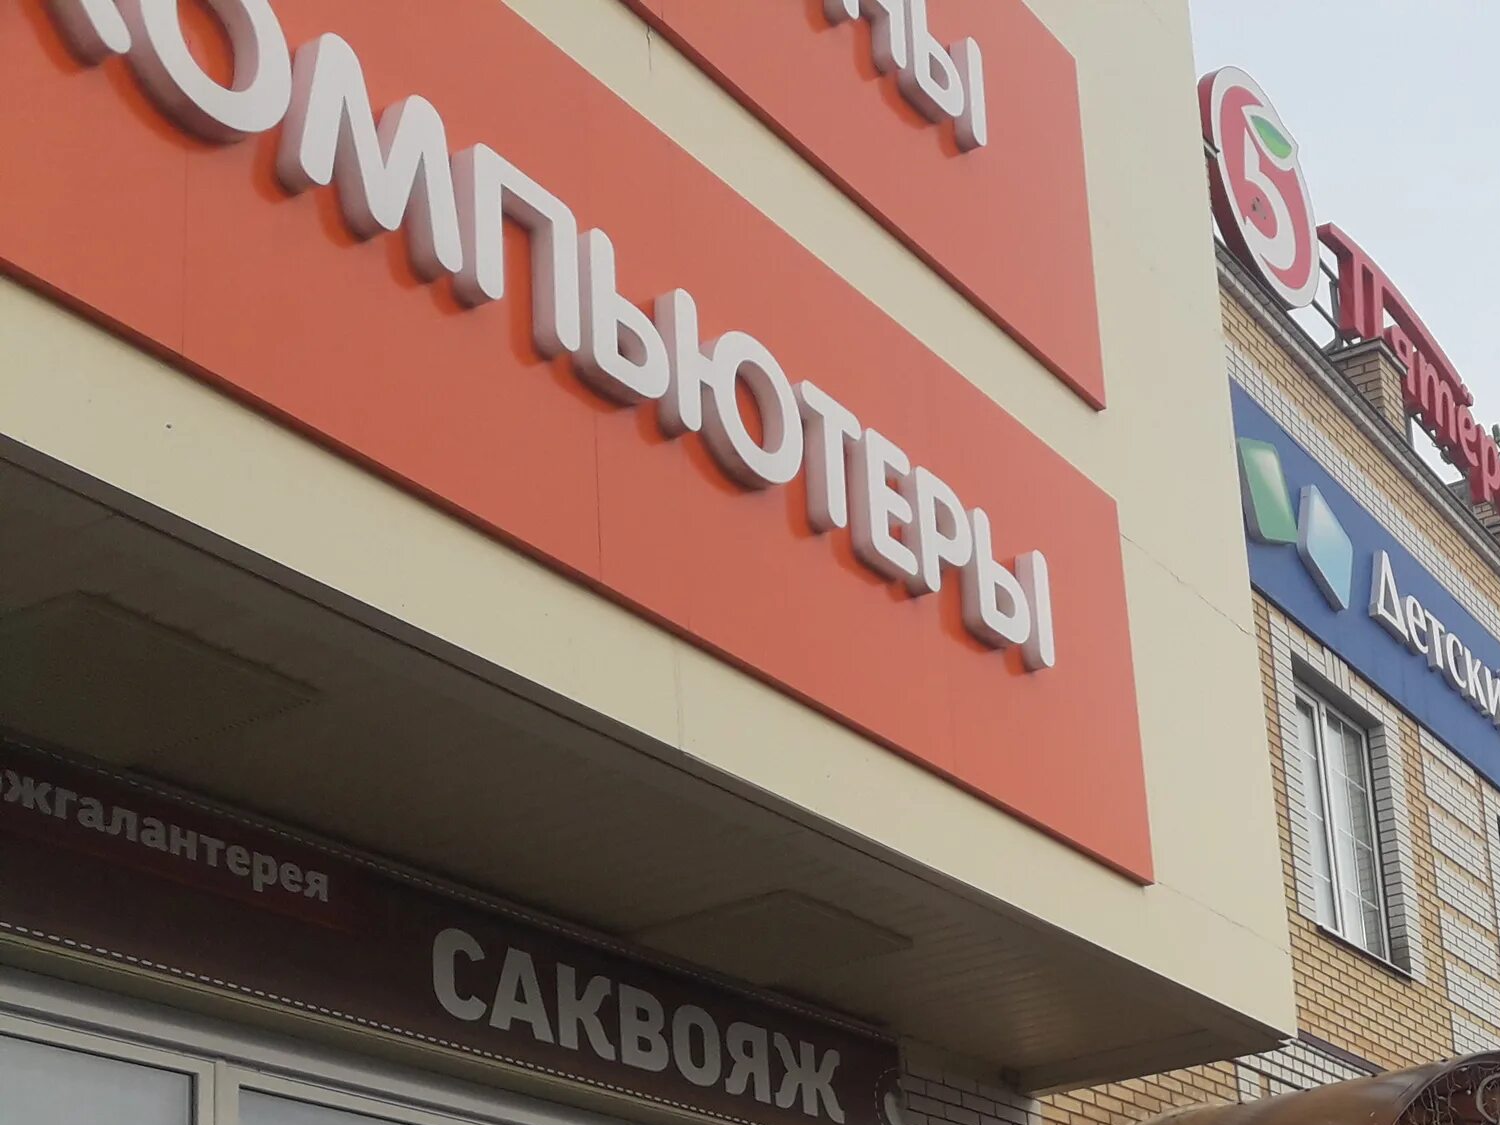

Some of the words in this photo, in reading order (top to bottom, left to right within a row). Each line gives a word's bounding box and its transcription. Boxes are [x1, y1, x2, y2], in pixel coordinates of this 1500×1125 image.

[75, 0, 1055, 668] ОМПЬЮТЕРЫ
[0, 768, 329, 902] жгалантерея
[432, 927, 845, 1124] САКВОЯЖ
